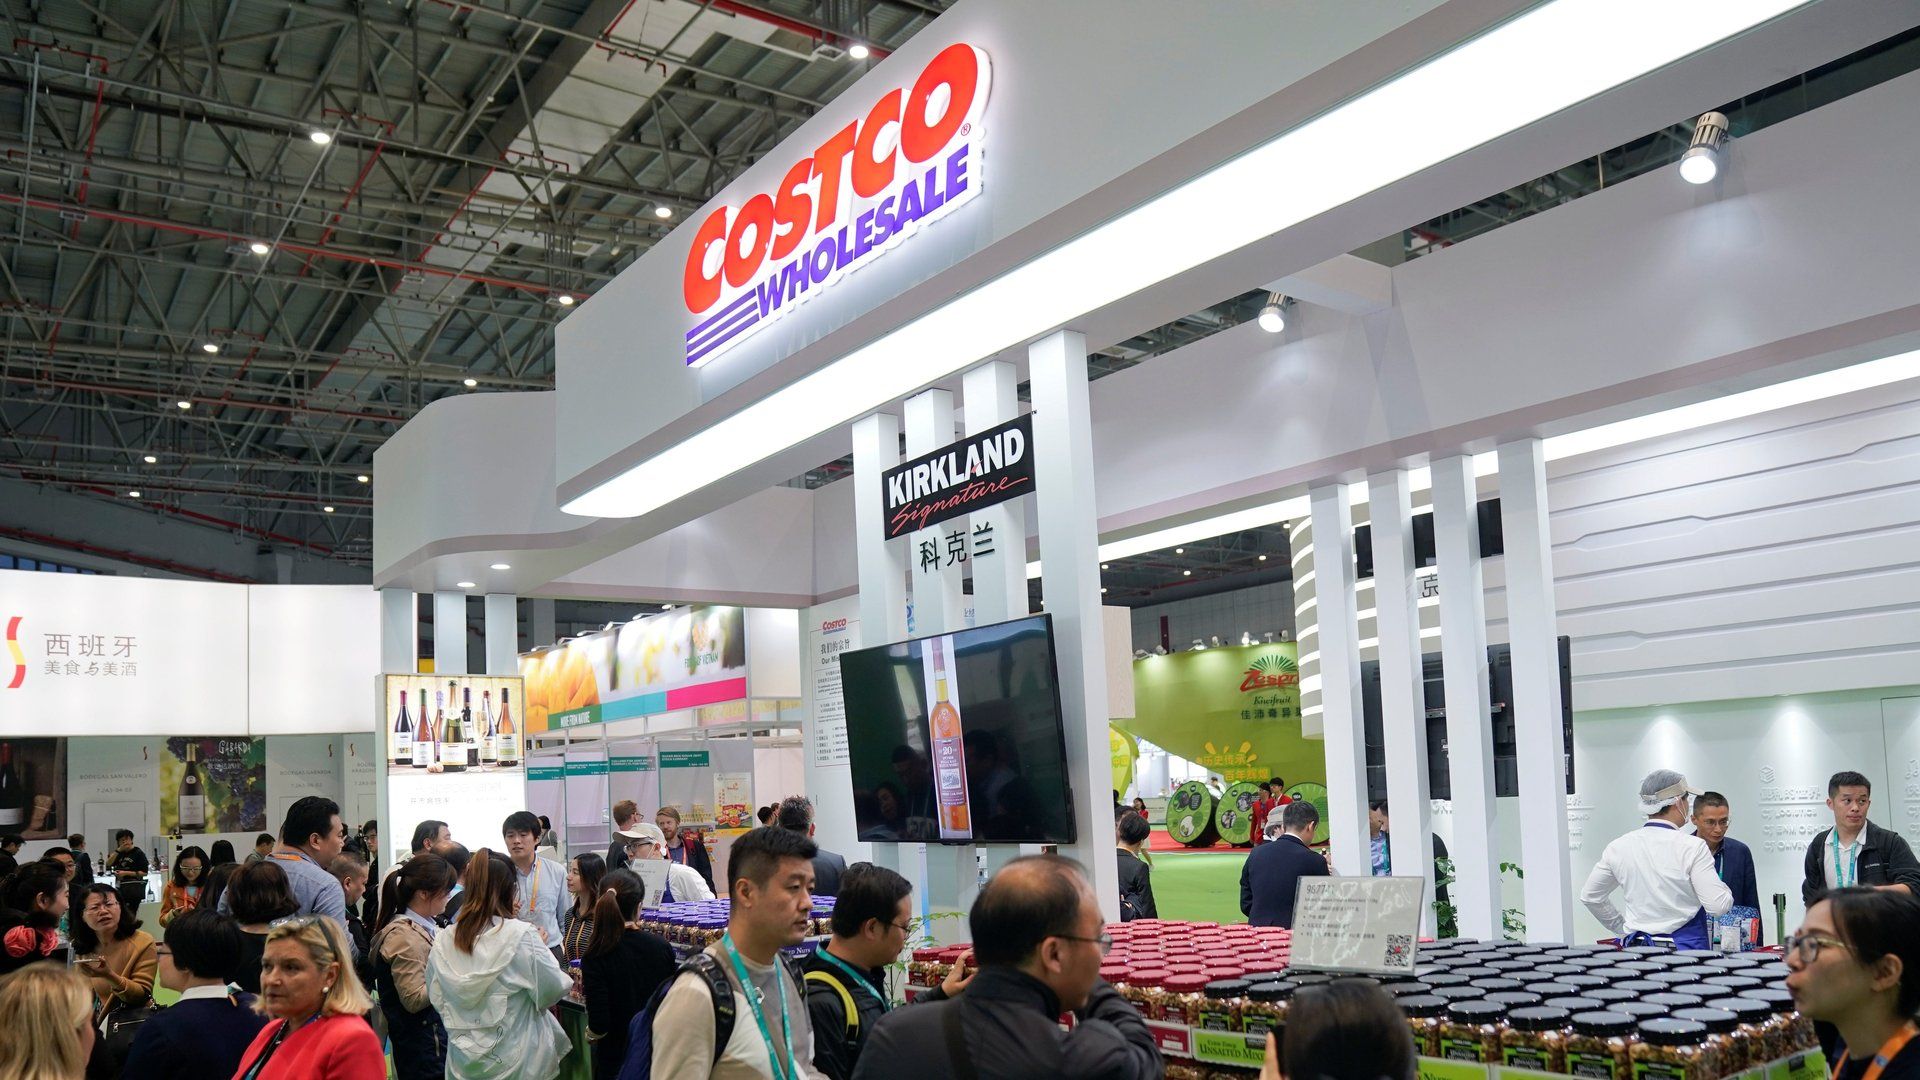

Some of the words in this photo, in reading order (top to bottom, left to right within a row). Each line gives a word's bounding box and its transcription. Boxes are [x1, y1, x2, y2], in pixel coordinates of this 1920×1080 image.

[684, 43, 978, 314] COSTCO
[757, 143, 969, 318] WHOLESALE
[888, 428, 1025, 509] KIRKLAND
[891, 476, 1028, 536] Signature
[919, 521, 996, 573] 科克兰
[822, 618, 847, 631] COSTCO
[44, 633, 138, 658] 西班牙
[44, 660, 138, 676] 美食与美酒
[702, 652, 719, 665] VIETNAM
[1253, 695, 1291, 706] Kiwifruit
[942, 746, 953, 755] 20
[1200, 1043, 1242, 1058] UNSALTED
